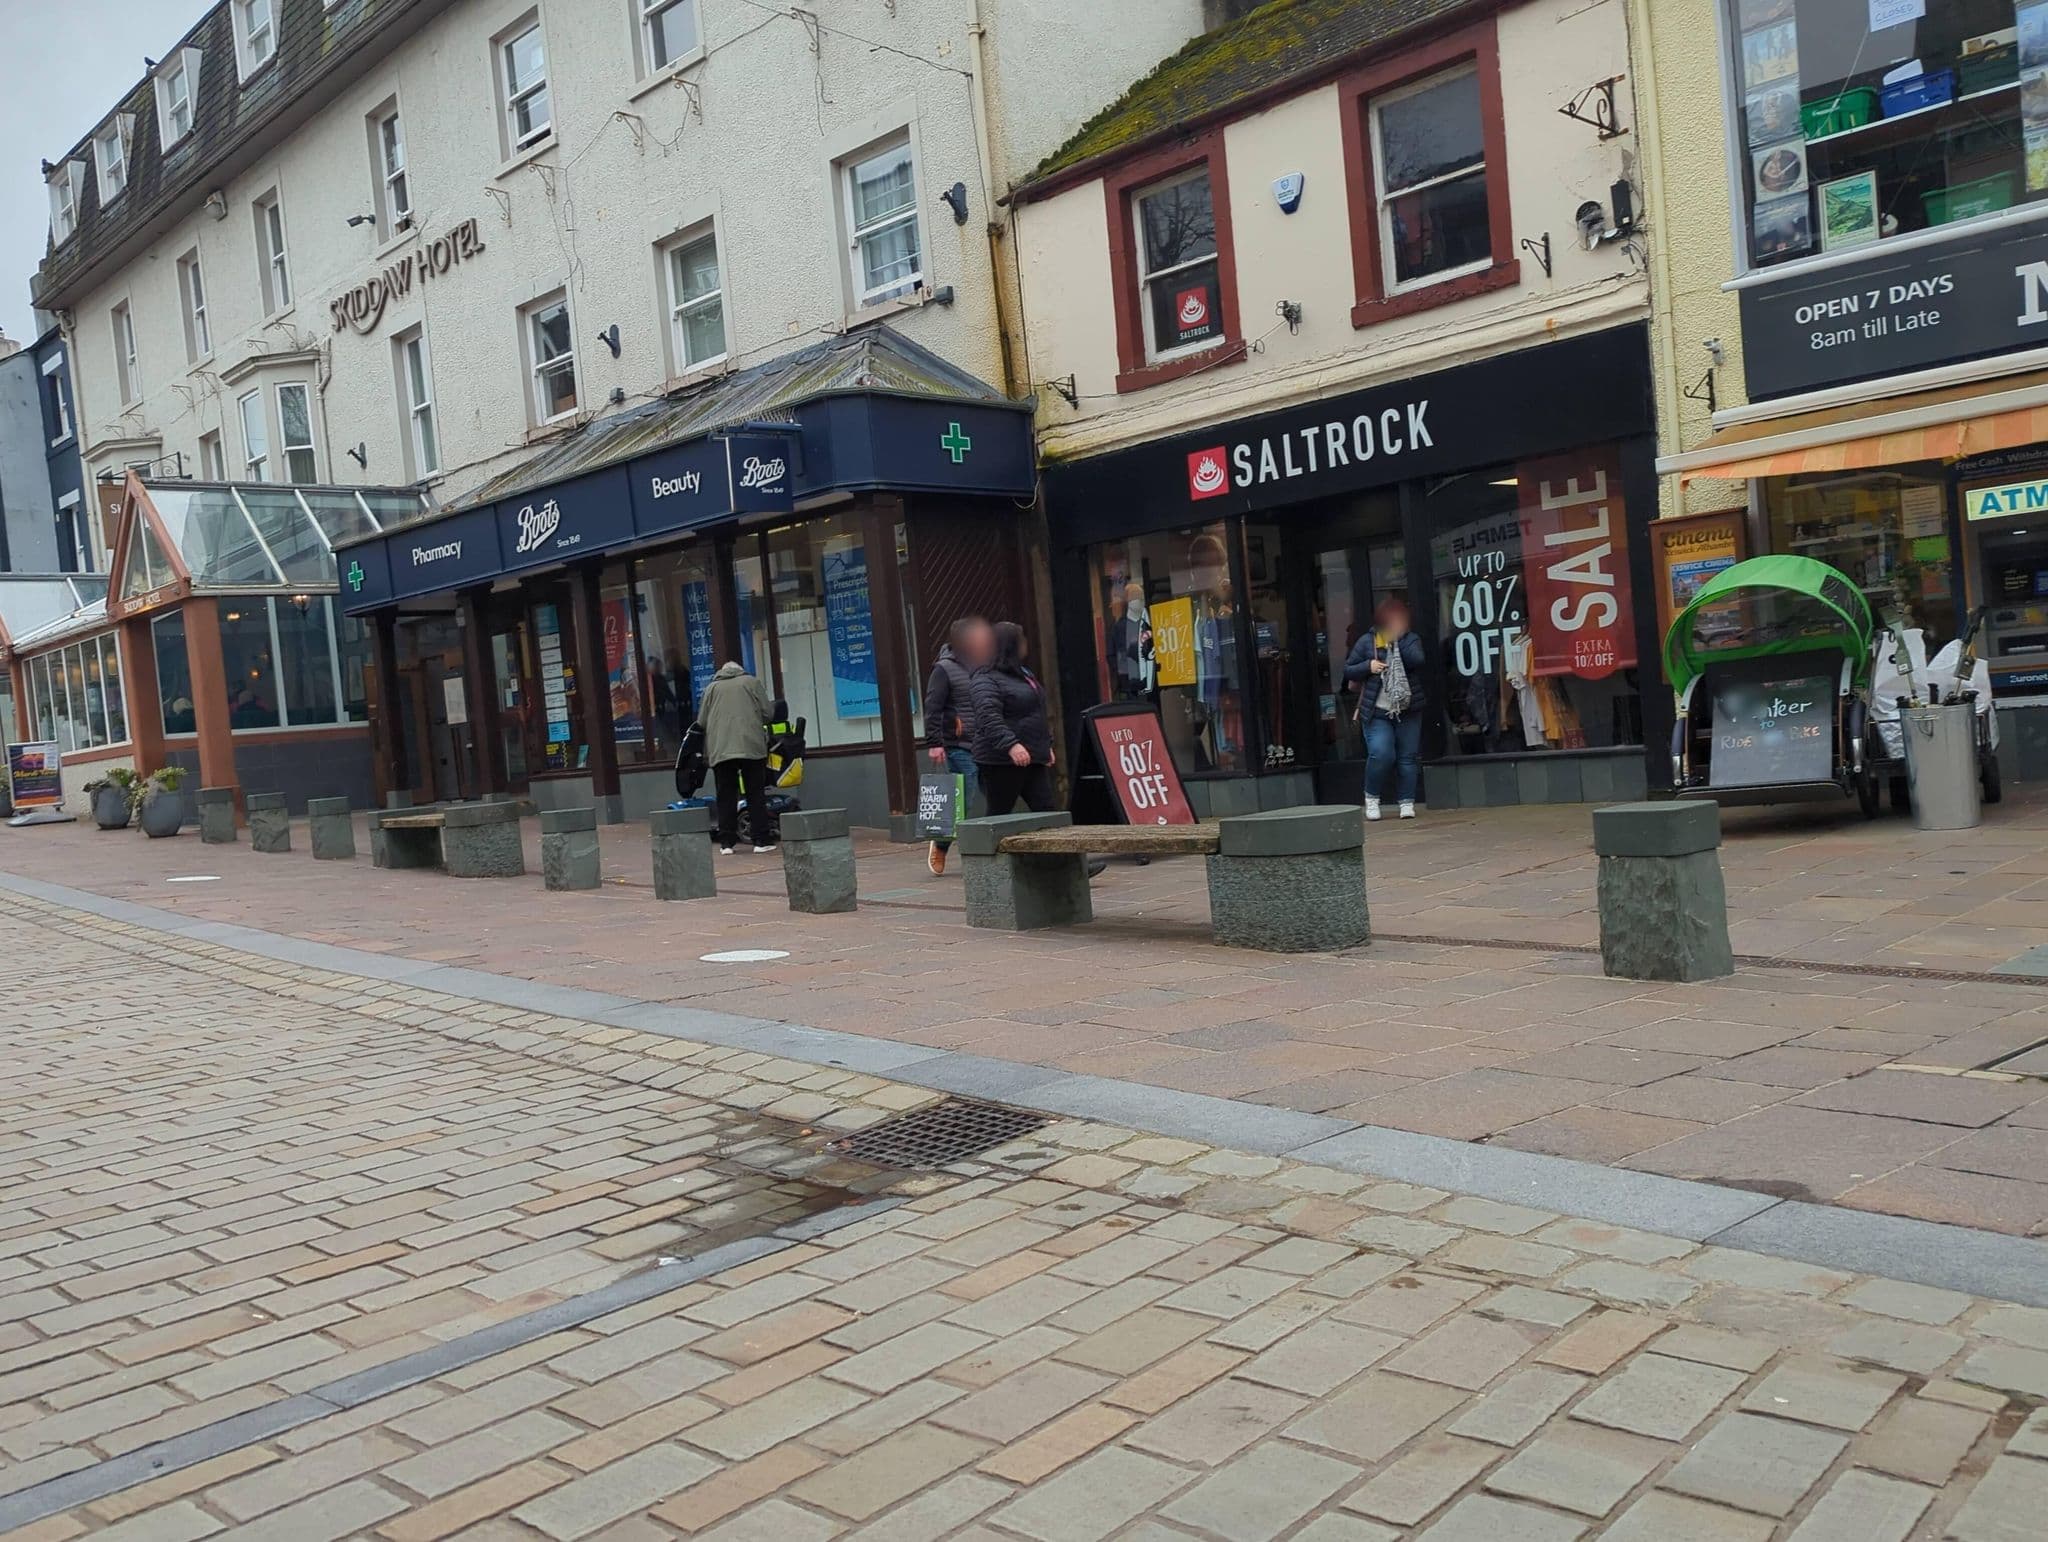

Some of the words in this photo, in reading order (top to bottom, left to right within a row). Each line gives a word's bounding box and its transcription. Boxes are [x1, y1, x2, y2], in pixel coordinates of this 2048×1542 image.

[330, 256, 413, 335] SKIDDAW
[416, 217, 486, 284] HOTEL
[1794, 295, 1859, 325] OPEN
[1866, 290, 1881, 309] 7
[1888, 273, 1954, 305] DAYS
[1179, 325, 1210, 340] SALTROCK
[1810, 327, 1856, 350] 8am
[1862, 315, 1888, 339] till
[1895, 310, 1941, 332] Late
[1233, 399, 1434, 488] SALTROCK
[651, 470, 701, 499] Beauty
[739, 455, 786, 488] Boots
[1979, 484, 2048, 515] ATM
[516, 499, 561, 553] Boots
[557, 538, 570, 549] Since
[569, 534, 581, 545] 1849
[412, 539, 462, 566] Pharmacy
[1458, 556, 1480, 578] UP
[1484, 550, 1505, 573] TO
[1540, 470, 1618, 632] SALE
[1452, 574, 1520, 629] 60%
[1156, 624, 1190, 654] 30%
[1455, 626, 1523, 677] OFF
[1575, 639, 1612, 654] EXTRA
[1574, 654, 1593, 668] 10%
[1594, 652, 1615, 666] OFF
[1119, 739, 1161, 776] 60%
[920, 803, 943, 812] COOL
[1128, 774, 1169, 809] OFF
